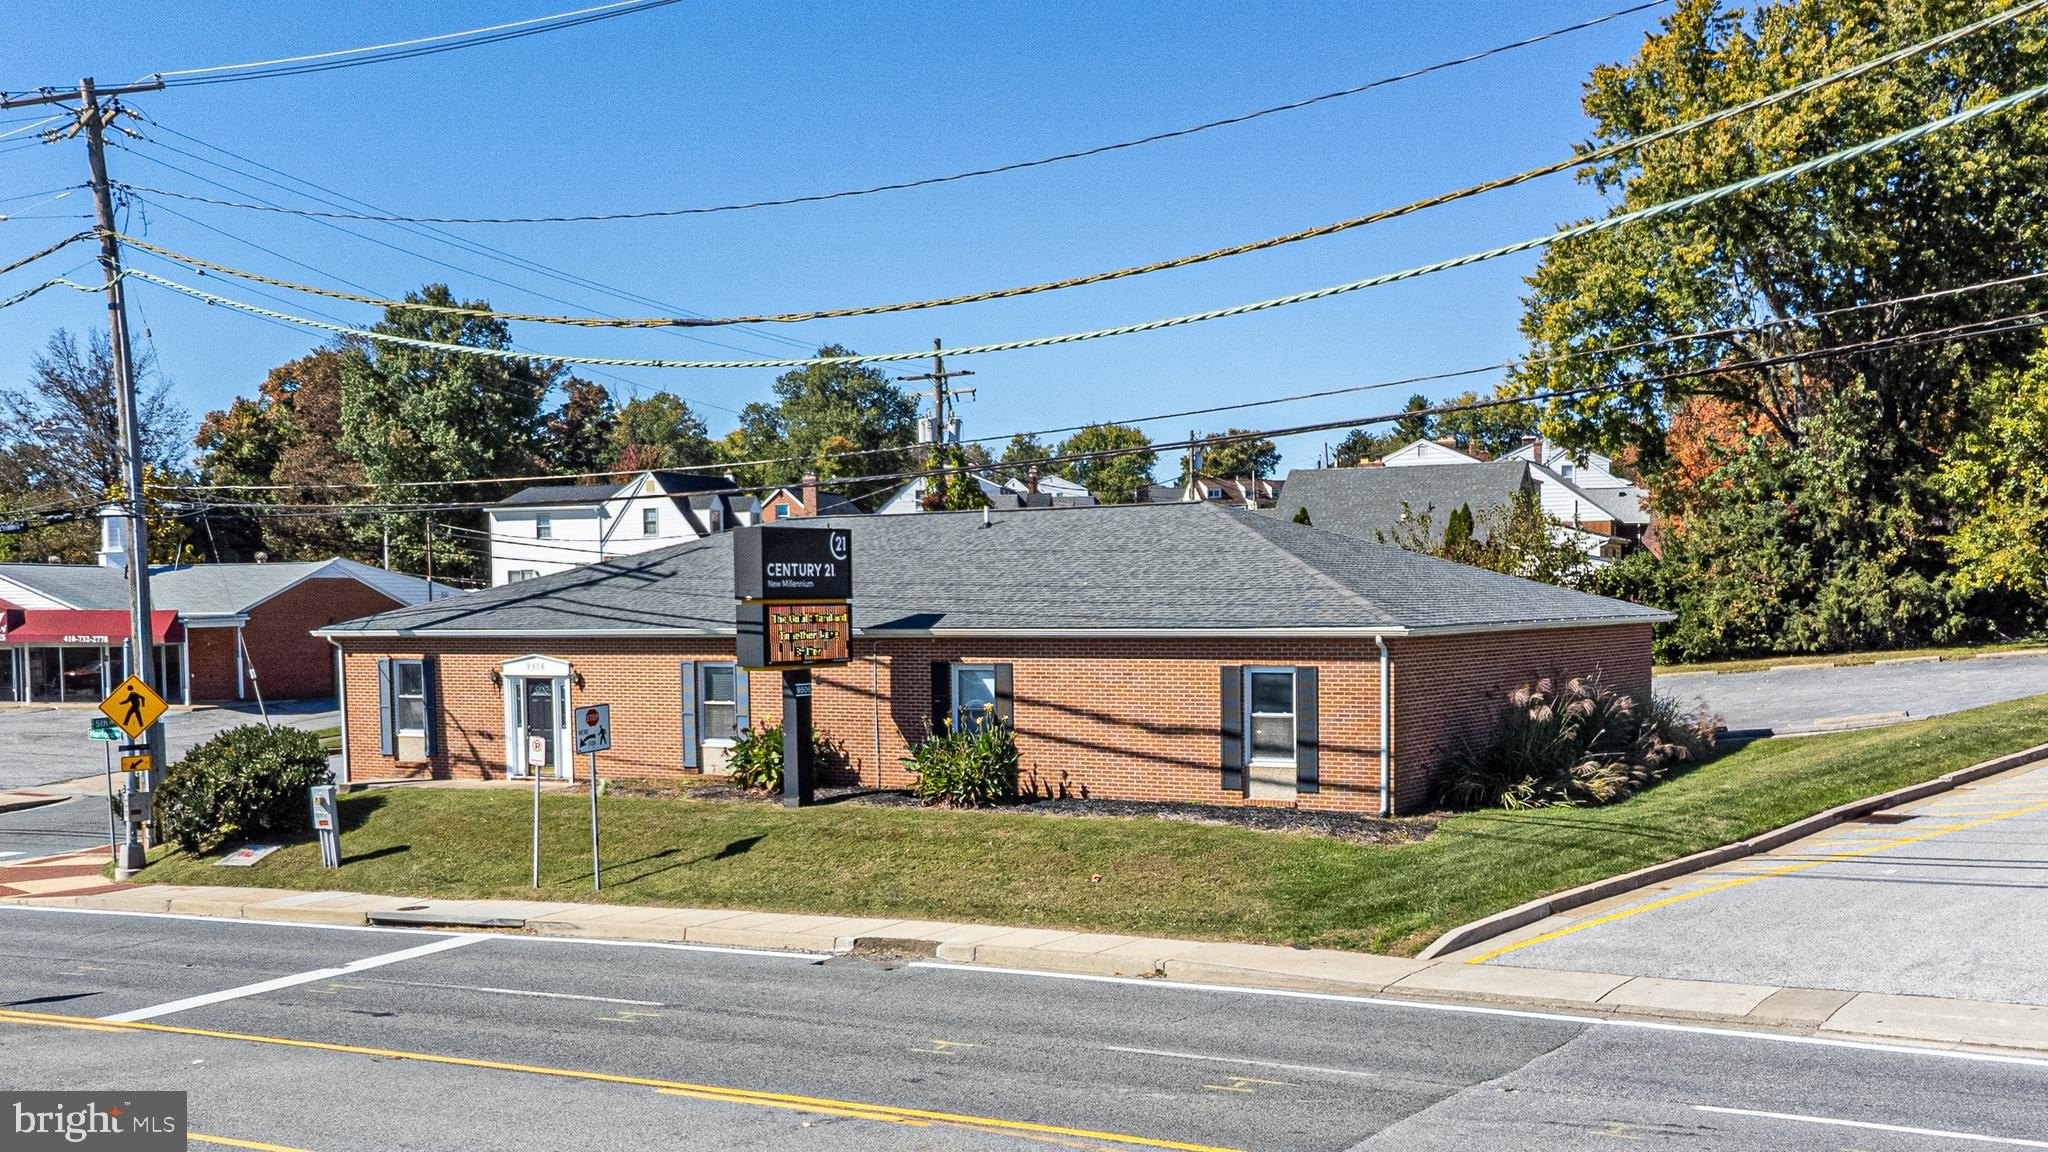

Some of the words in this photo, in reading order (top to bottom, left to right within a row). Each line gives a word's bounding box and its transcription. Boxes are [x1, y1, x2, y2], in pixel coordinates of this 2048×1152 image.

[835, 536, 846, 551] 21
[767, 563, 821, 577] CENTURY
[824, 563, 835, 577] 21
[767, 579, 782, 588] New
[782, 579, 815, 588] Millennium
[779, 631, 817, 640] Toether
[586, 714, 598, 722] STOP
[95, 719, 109, 728] 5th
